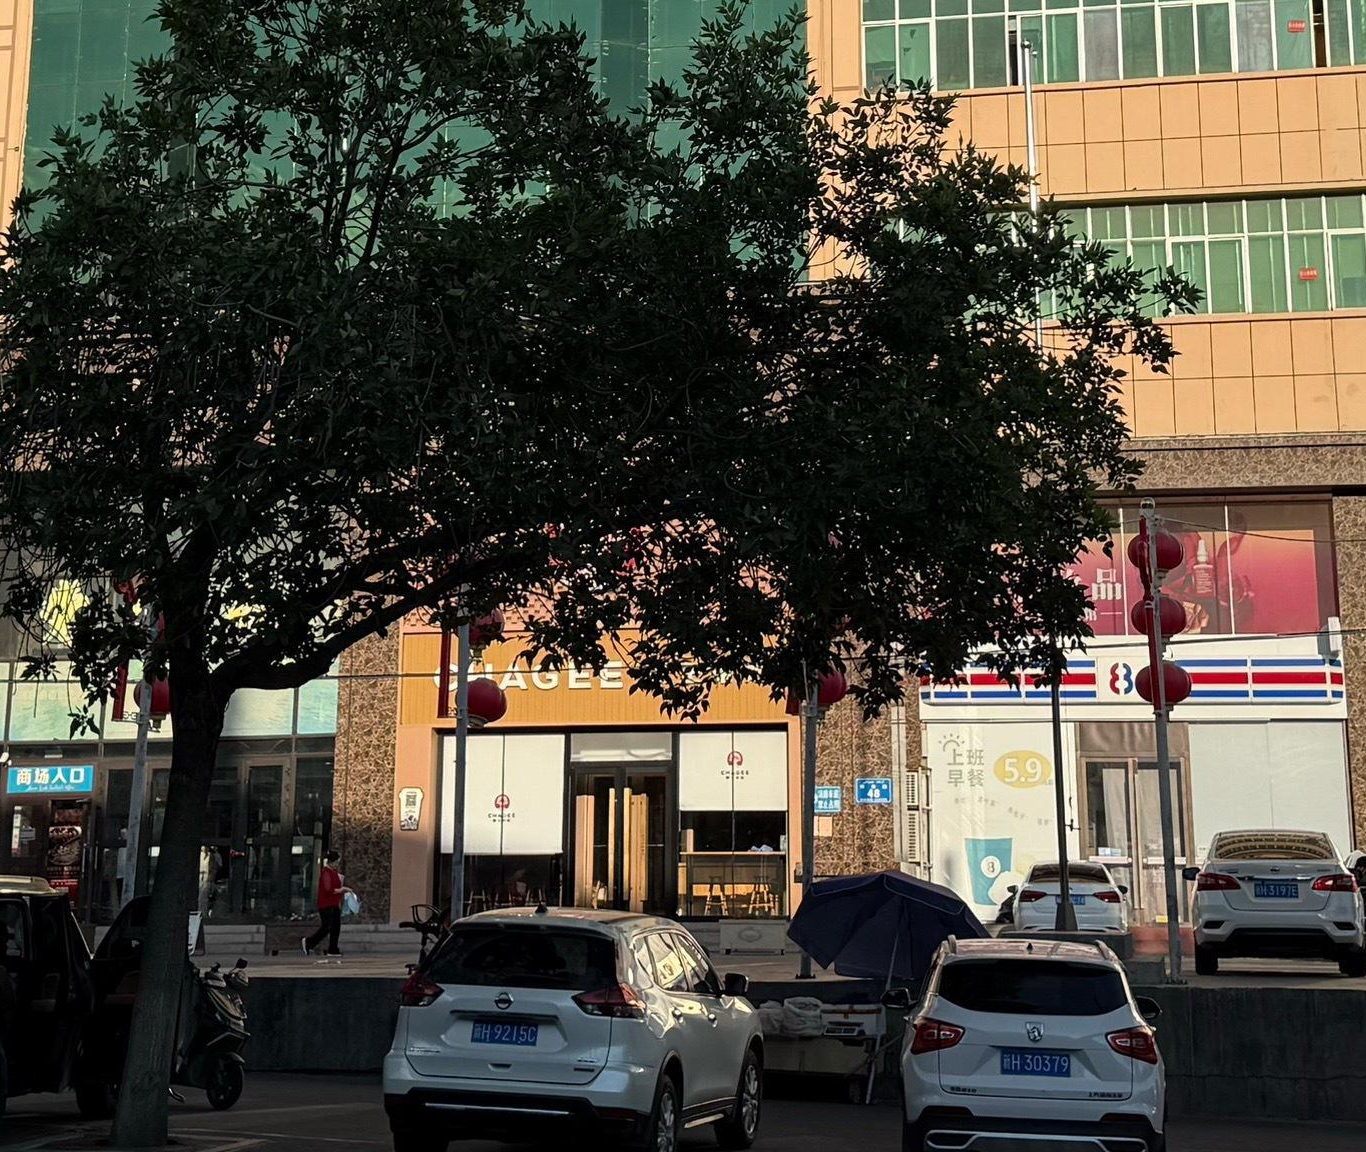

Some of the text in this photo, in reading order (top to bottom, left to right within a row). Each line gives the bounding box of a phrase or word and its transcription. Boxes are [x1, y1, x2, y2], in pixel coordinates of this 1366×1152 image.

[947, 748, 985, 766] 上班
[16, 767, 86, 786] 商场入口
[947, 769, 985, 787] 早餐
[1004, 757, 1043, 783] 5.9
